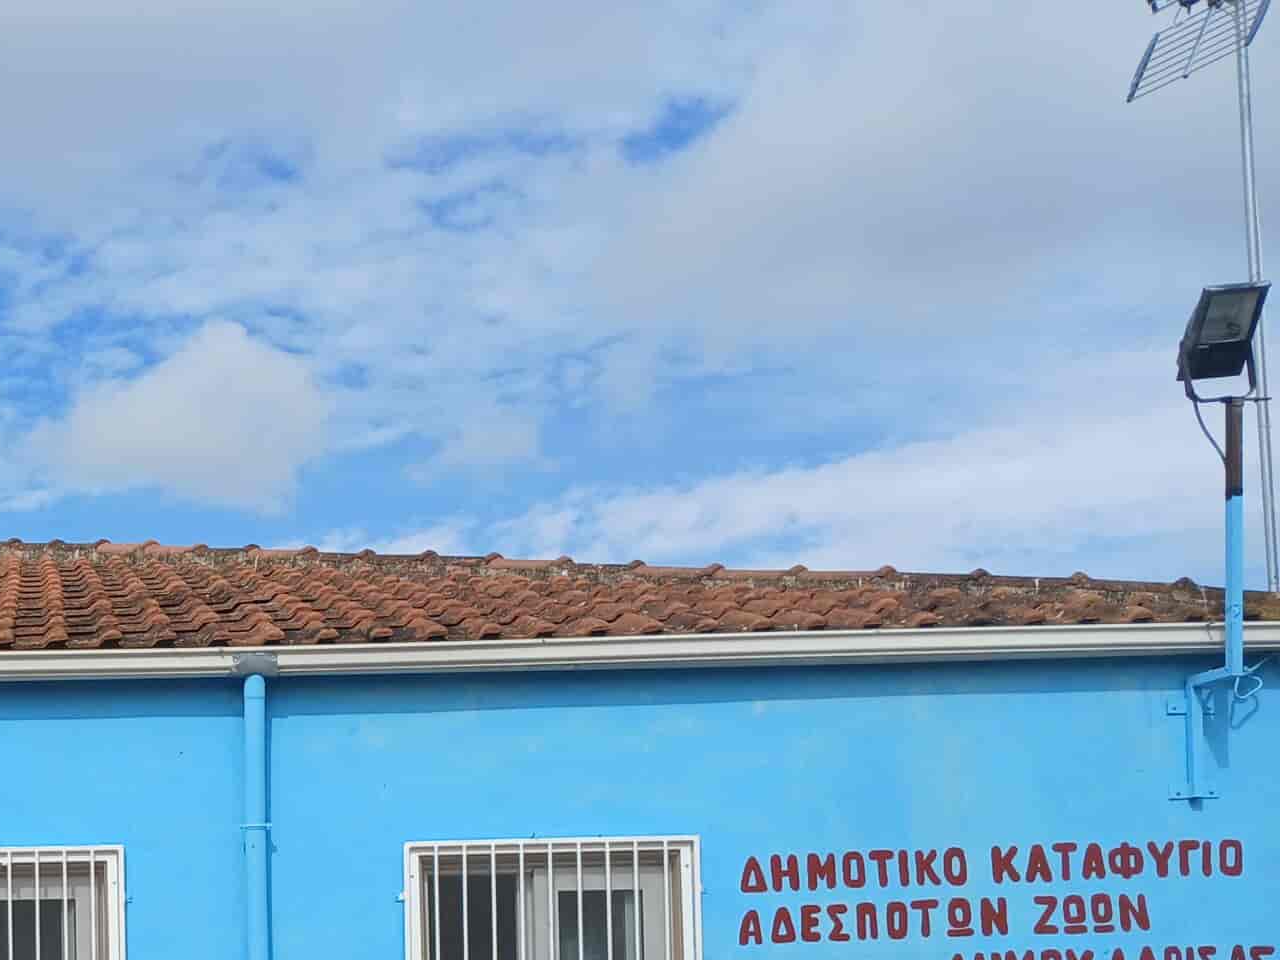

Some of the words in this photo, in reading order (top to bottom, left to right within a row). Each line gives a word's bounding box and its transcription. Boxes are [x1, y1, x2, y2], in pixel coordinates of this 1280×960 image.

[740, 847, 968, 893] ΔΗΜΟΤΙΚΟ
[990, 839, 1244, 884] ΚΑΤΑΦΥΓΙΟ
[738, 896, 1009, 946] ΑΔΕΣΠΟΤΩΝ
[1033, 893, 1151, 935] ΖΩΩΝ
